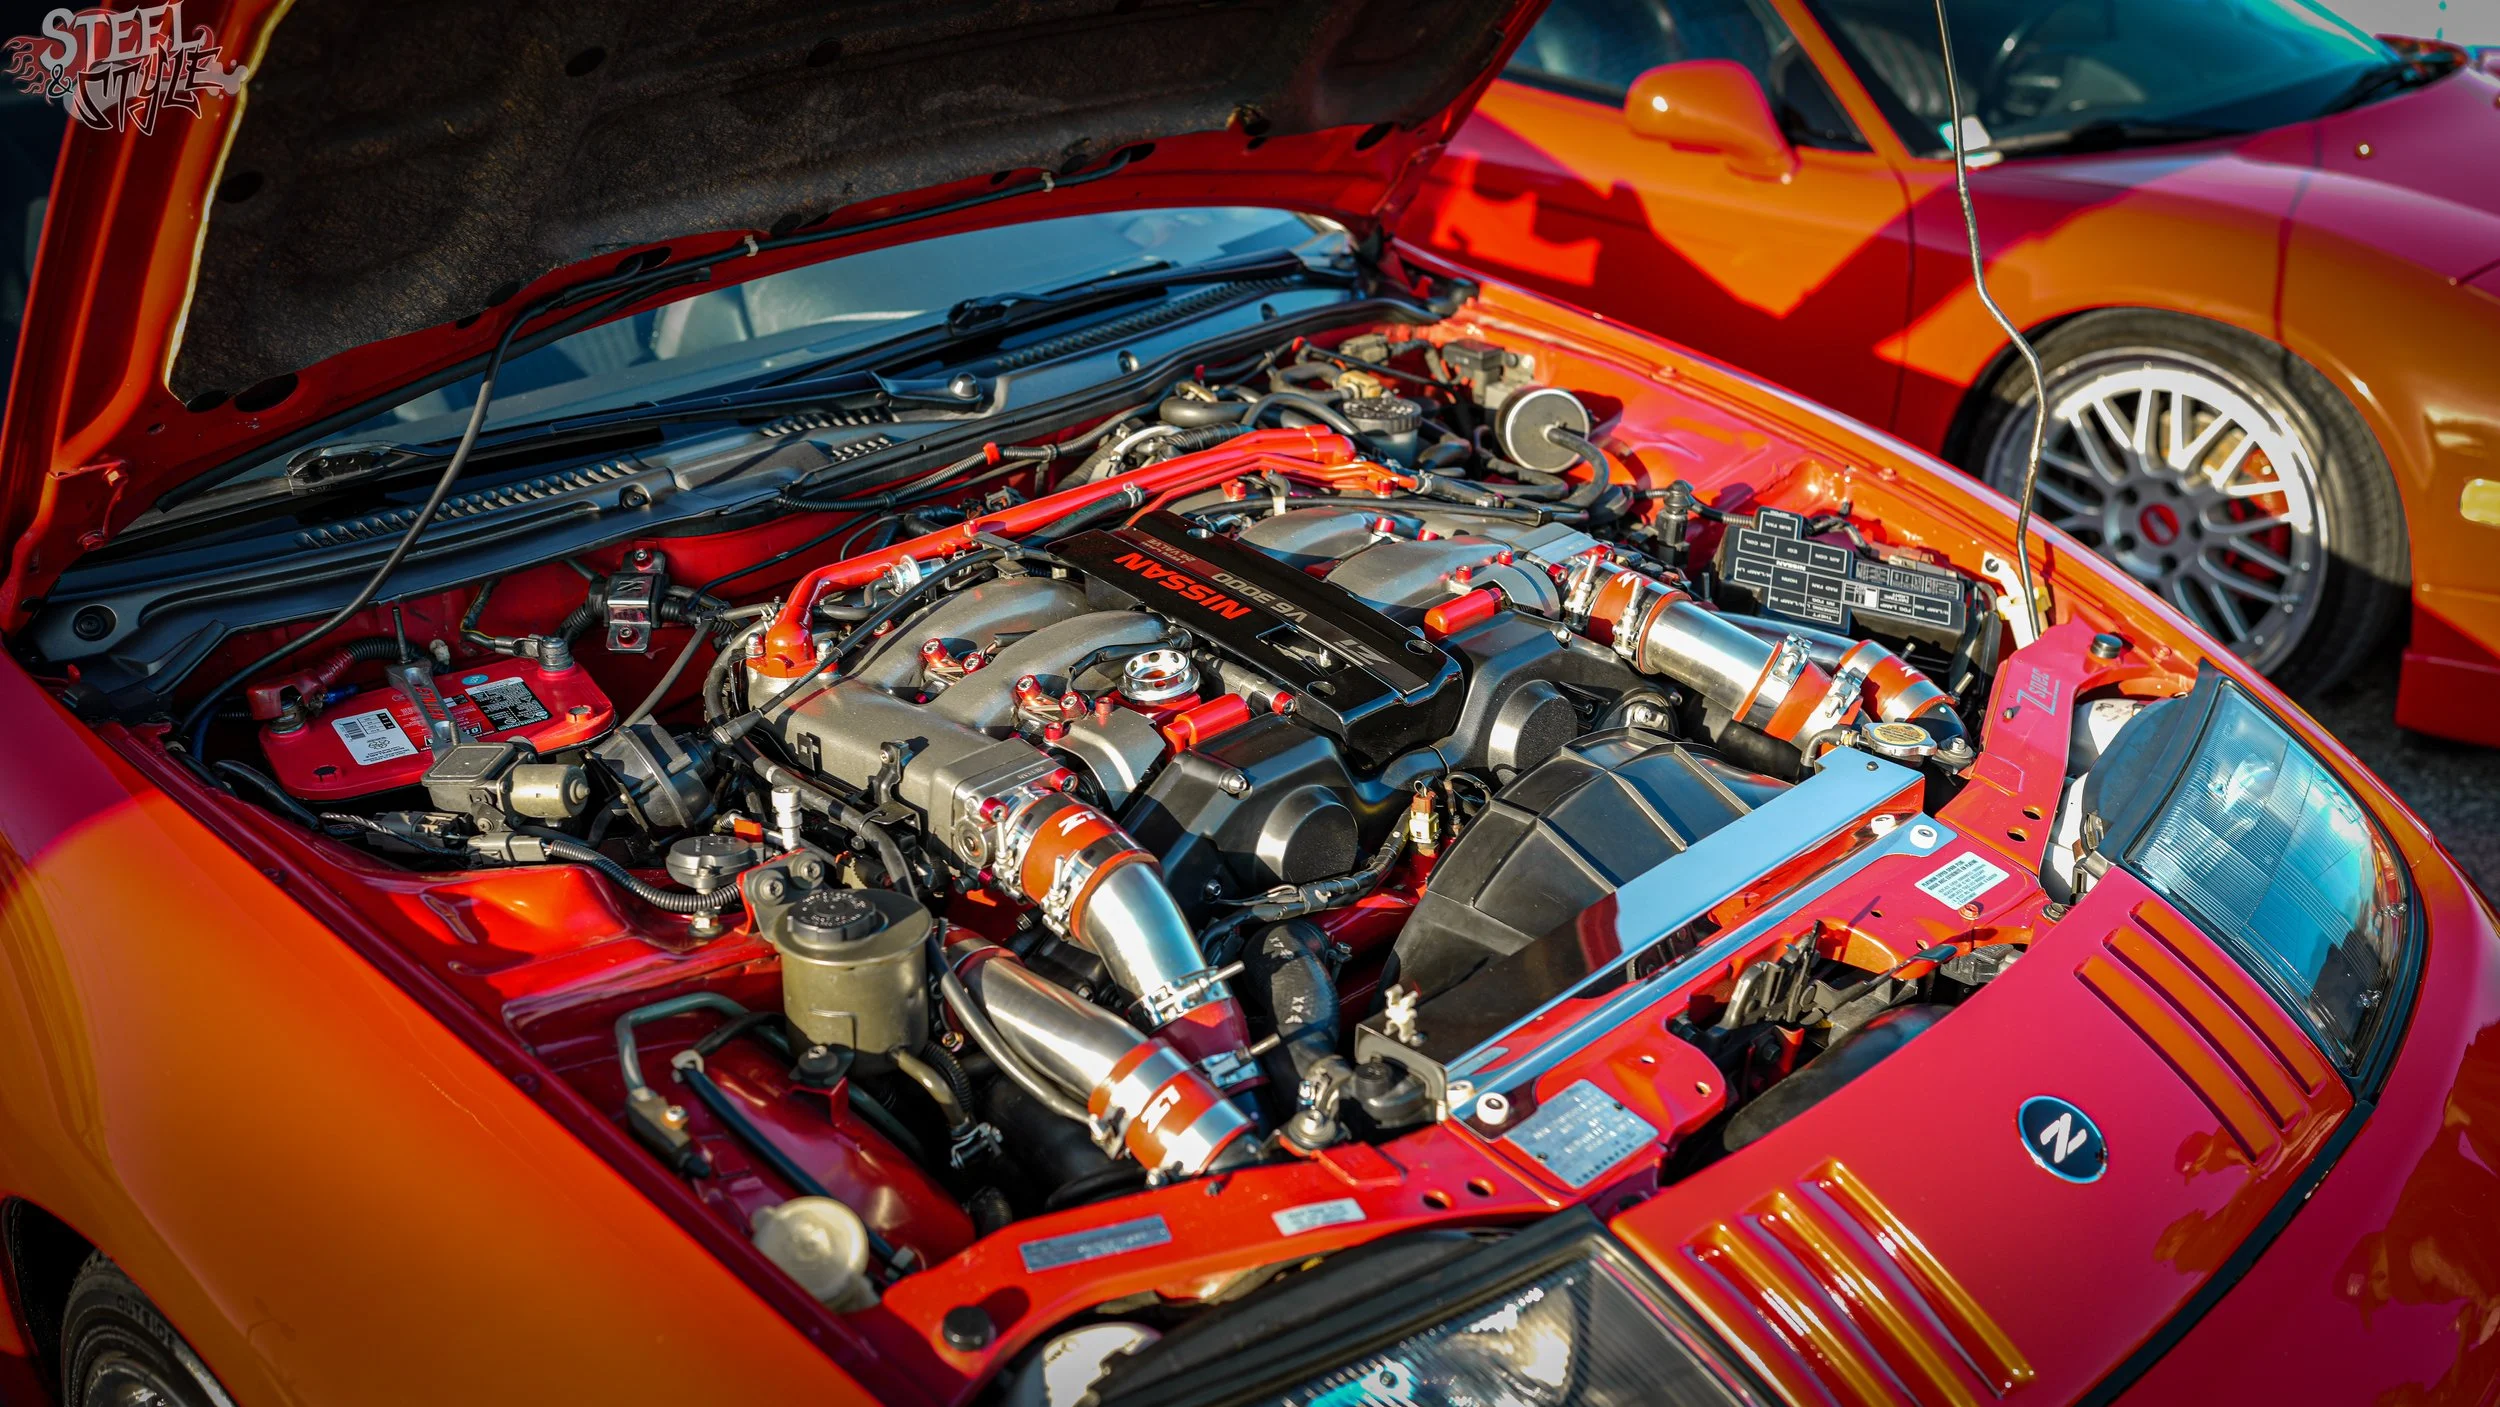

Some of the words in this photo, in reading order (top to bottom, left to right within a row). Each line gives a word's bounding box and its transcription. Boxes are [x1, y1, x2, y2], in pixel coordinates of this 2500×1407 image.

[1764, 520, 1777, 529] FAN
[1147, 539, 1180, 556] VALVE
[1814, 552, 1828, 560] CON
[1828, 555, 1840, 563] AIR
[1775, 559, 1806, 571] NISSAN
[1780, 575, 1798, 584] HORN
[1113, 552, 1252, 620] NISSAN
[1211, 573, 1272, 604] 3000
[1824, 585, 1838, 593] RAD
[1811, 596, 1824, 604] FOG
[1879, 601, 1897, 610] LAMP
[1898, 605, 1911, 613] FOG
[1271, 602, 1308, 623] V6
[1812, 611, 1832, 620] THEFT
